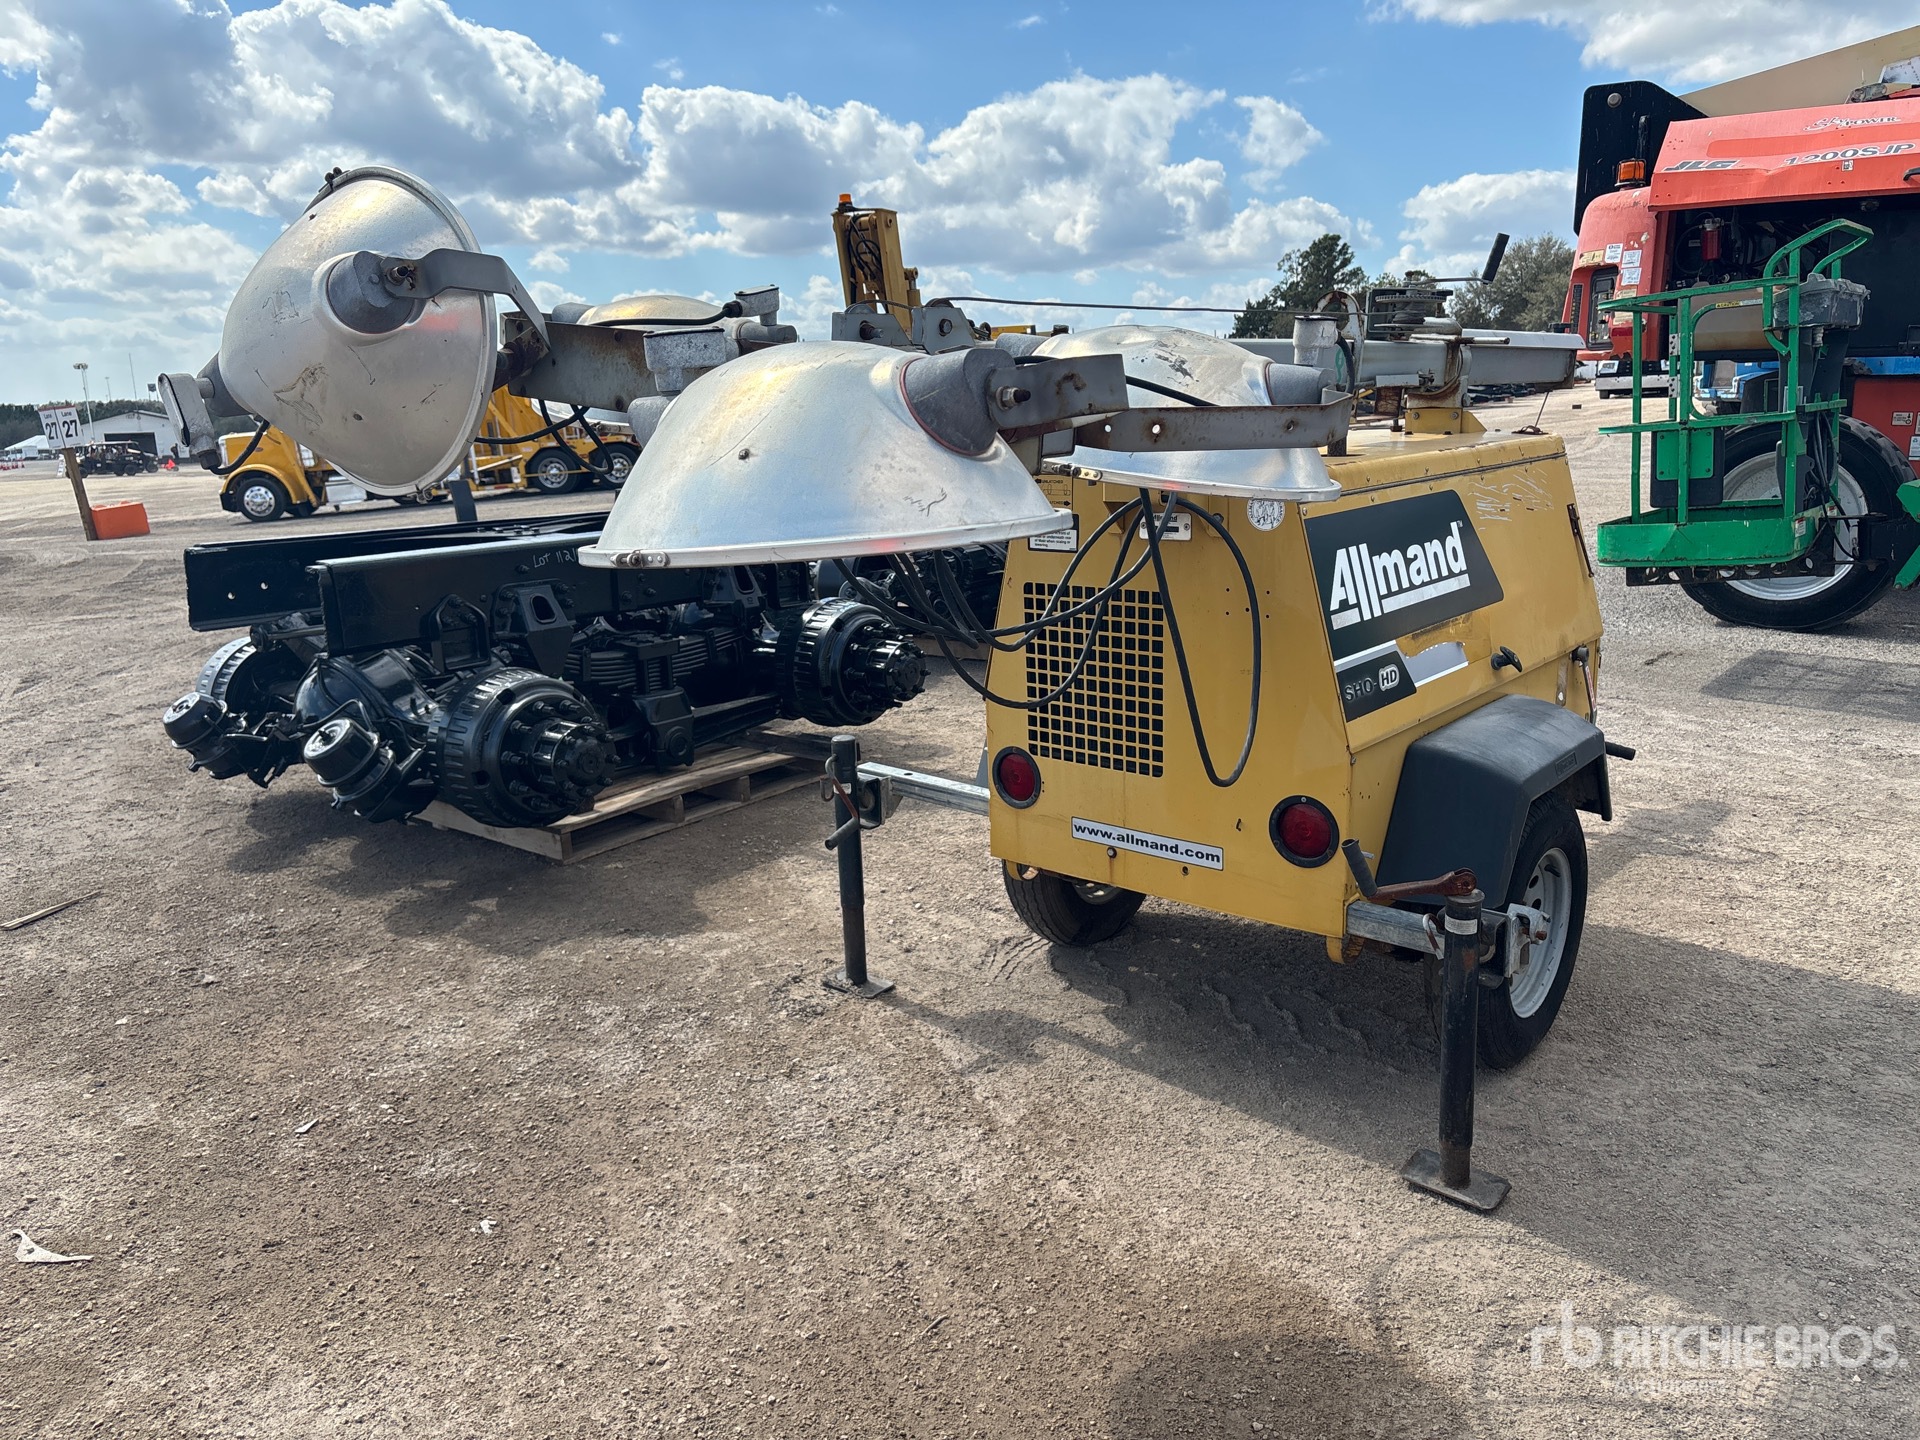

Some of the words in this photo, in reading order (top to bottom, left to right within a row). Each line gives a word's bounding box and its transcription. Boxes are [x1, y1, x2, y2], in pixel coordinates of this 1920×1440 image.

[1782, 142, 1915, 168] 1200SJP
[1664, 160, 1737, 172] JLG
[45, 422, 59, 440] 27
[62, 420, 79, 438] 27
[533, 551, 551, 568] Lot
[1329, 520, 1468, 622] Allmand
[1073, 823, 1221, 863] www.allmand.com
